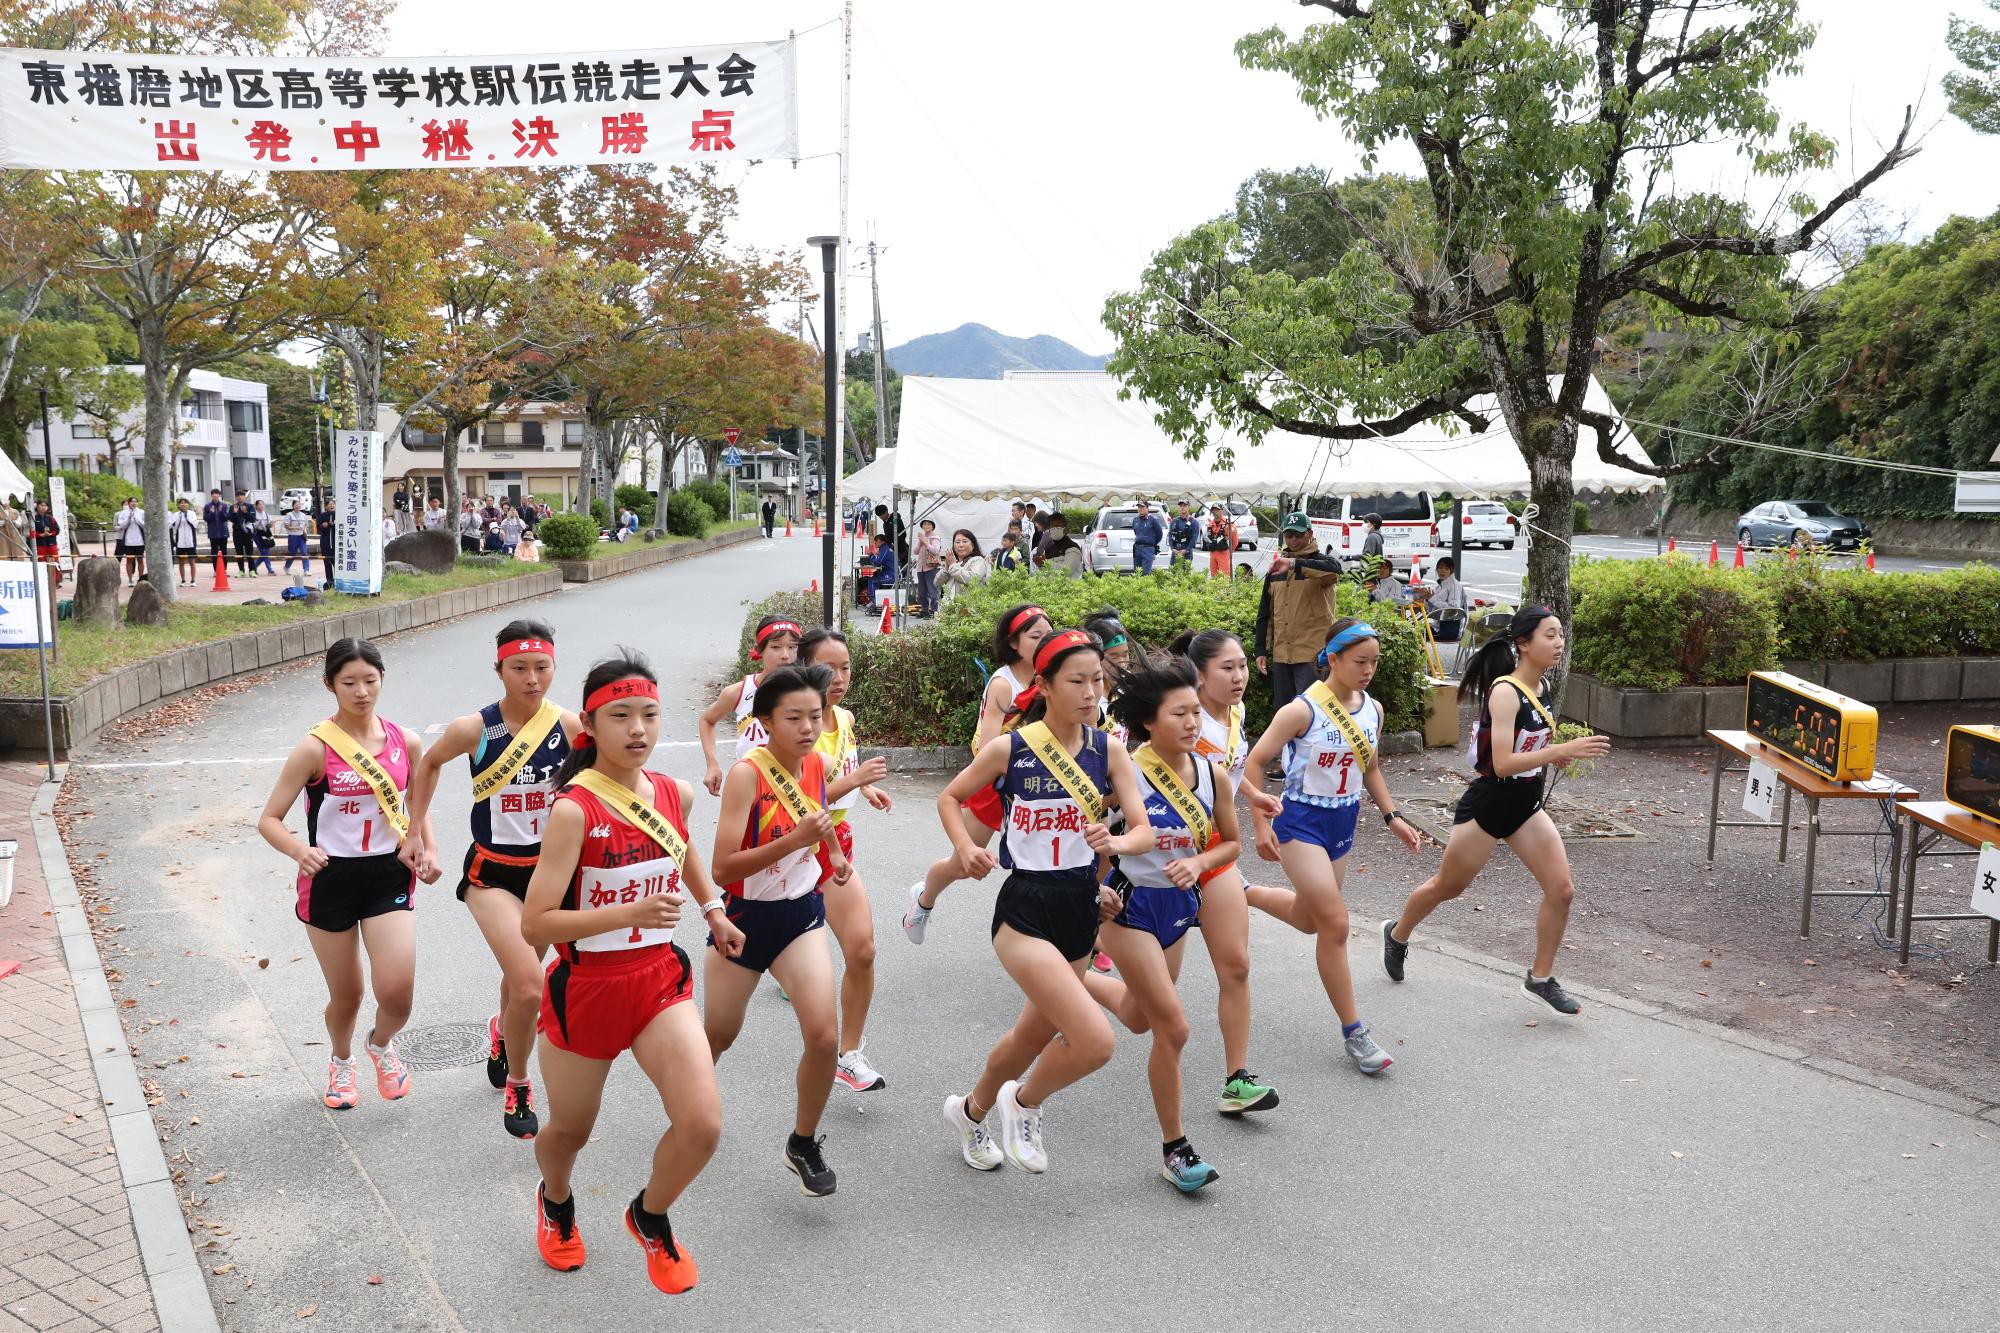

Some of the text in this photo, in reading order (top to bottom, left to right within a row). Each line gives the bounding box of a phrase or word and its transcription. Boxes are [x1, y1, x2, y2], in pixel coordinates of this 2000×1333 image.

[346, 435, 359, 572] みんなで築こう明るい家庭
[1327, 728, 1375, 745] 明北
[1023, 776, 1065, 794] 明石
[1335, 767, 1348, 795] 1
[1751, 777, 1774, 804] 男子
[361, 820, 372, 851] 1
[530, 817, 538, 836] 1
[1051, 836, 1060, 867] 1
[589, 868, 682, 910] 加古川東
[1981, 870, 1997, 894] 女
